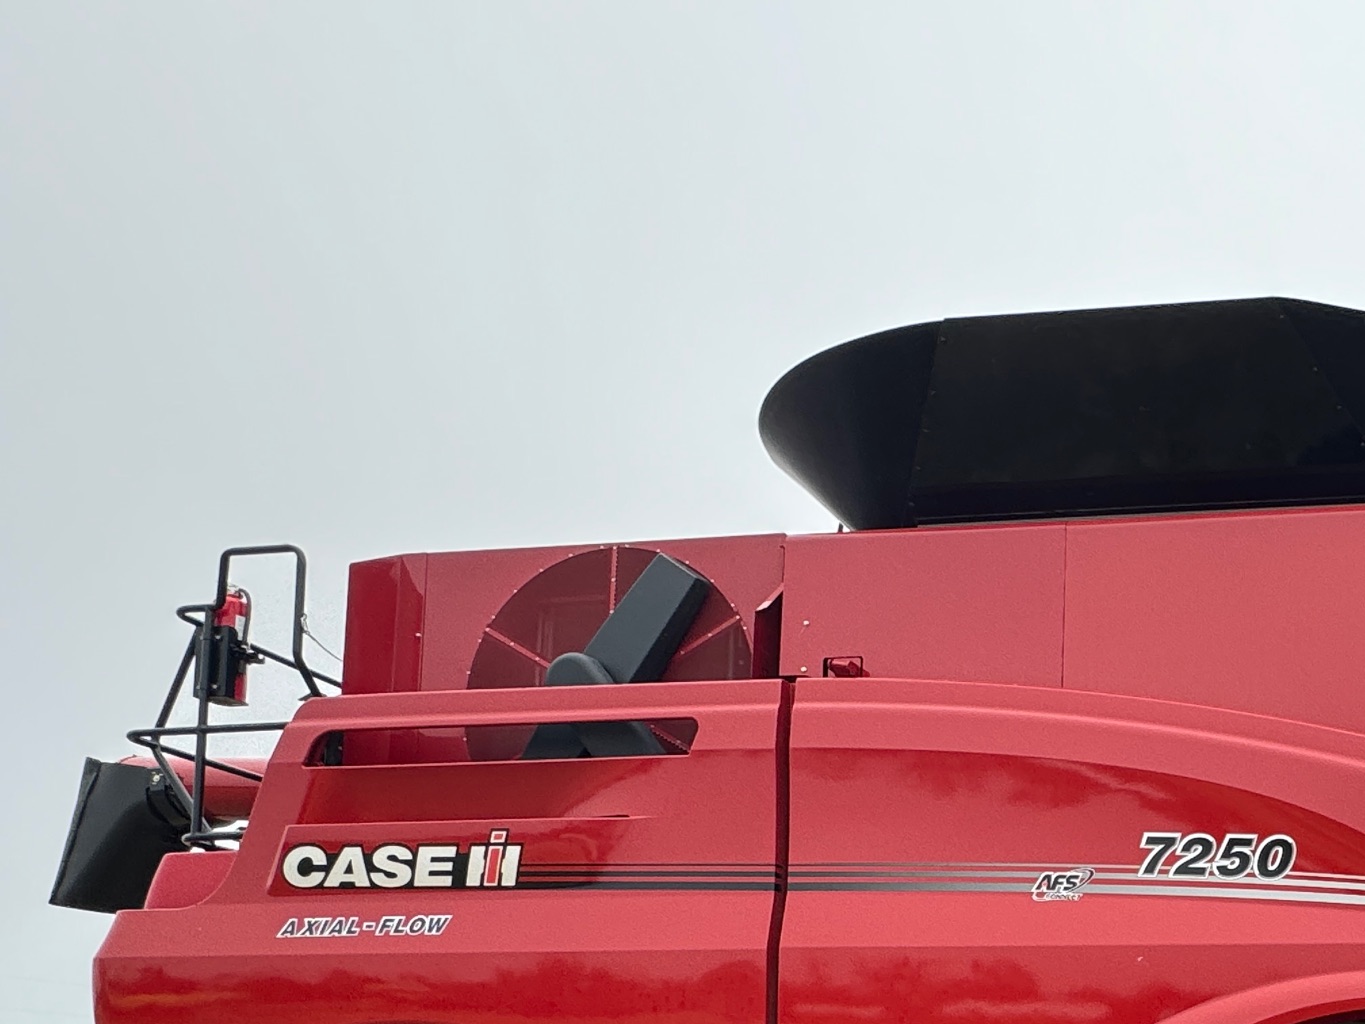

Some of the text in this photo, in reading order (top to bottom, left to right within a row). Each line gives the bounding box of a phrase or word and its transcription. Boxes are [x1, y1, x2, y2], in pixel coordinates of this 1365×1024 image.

[283, 845, 457, 888] CASE
[1138, 832, 1297, 881] 7250
[1031, 872, 1082, 892] AFS
[276, 915, 452, 938] AXIAL-FLOW
